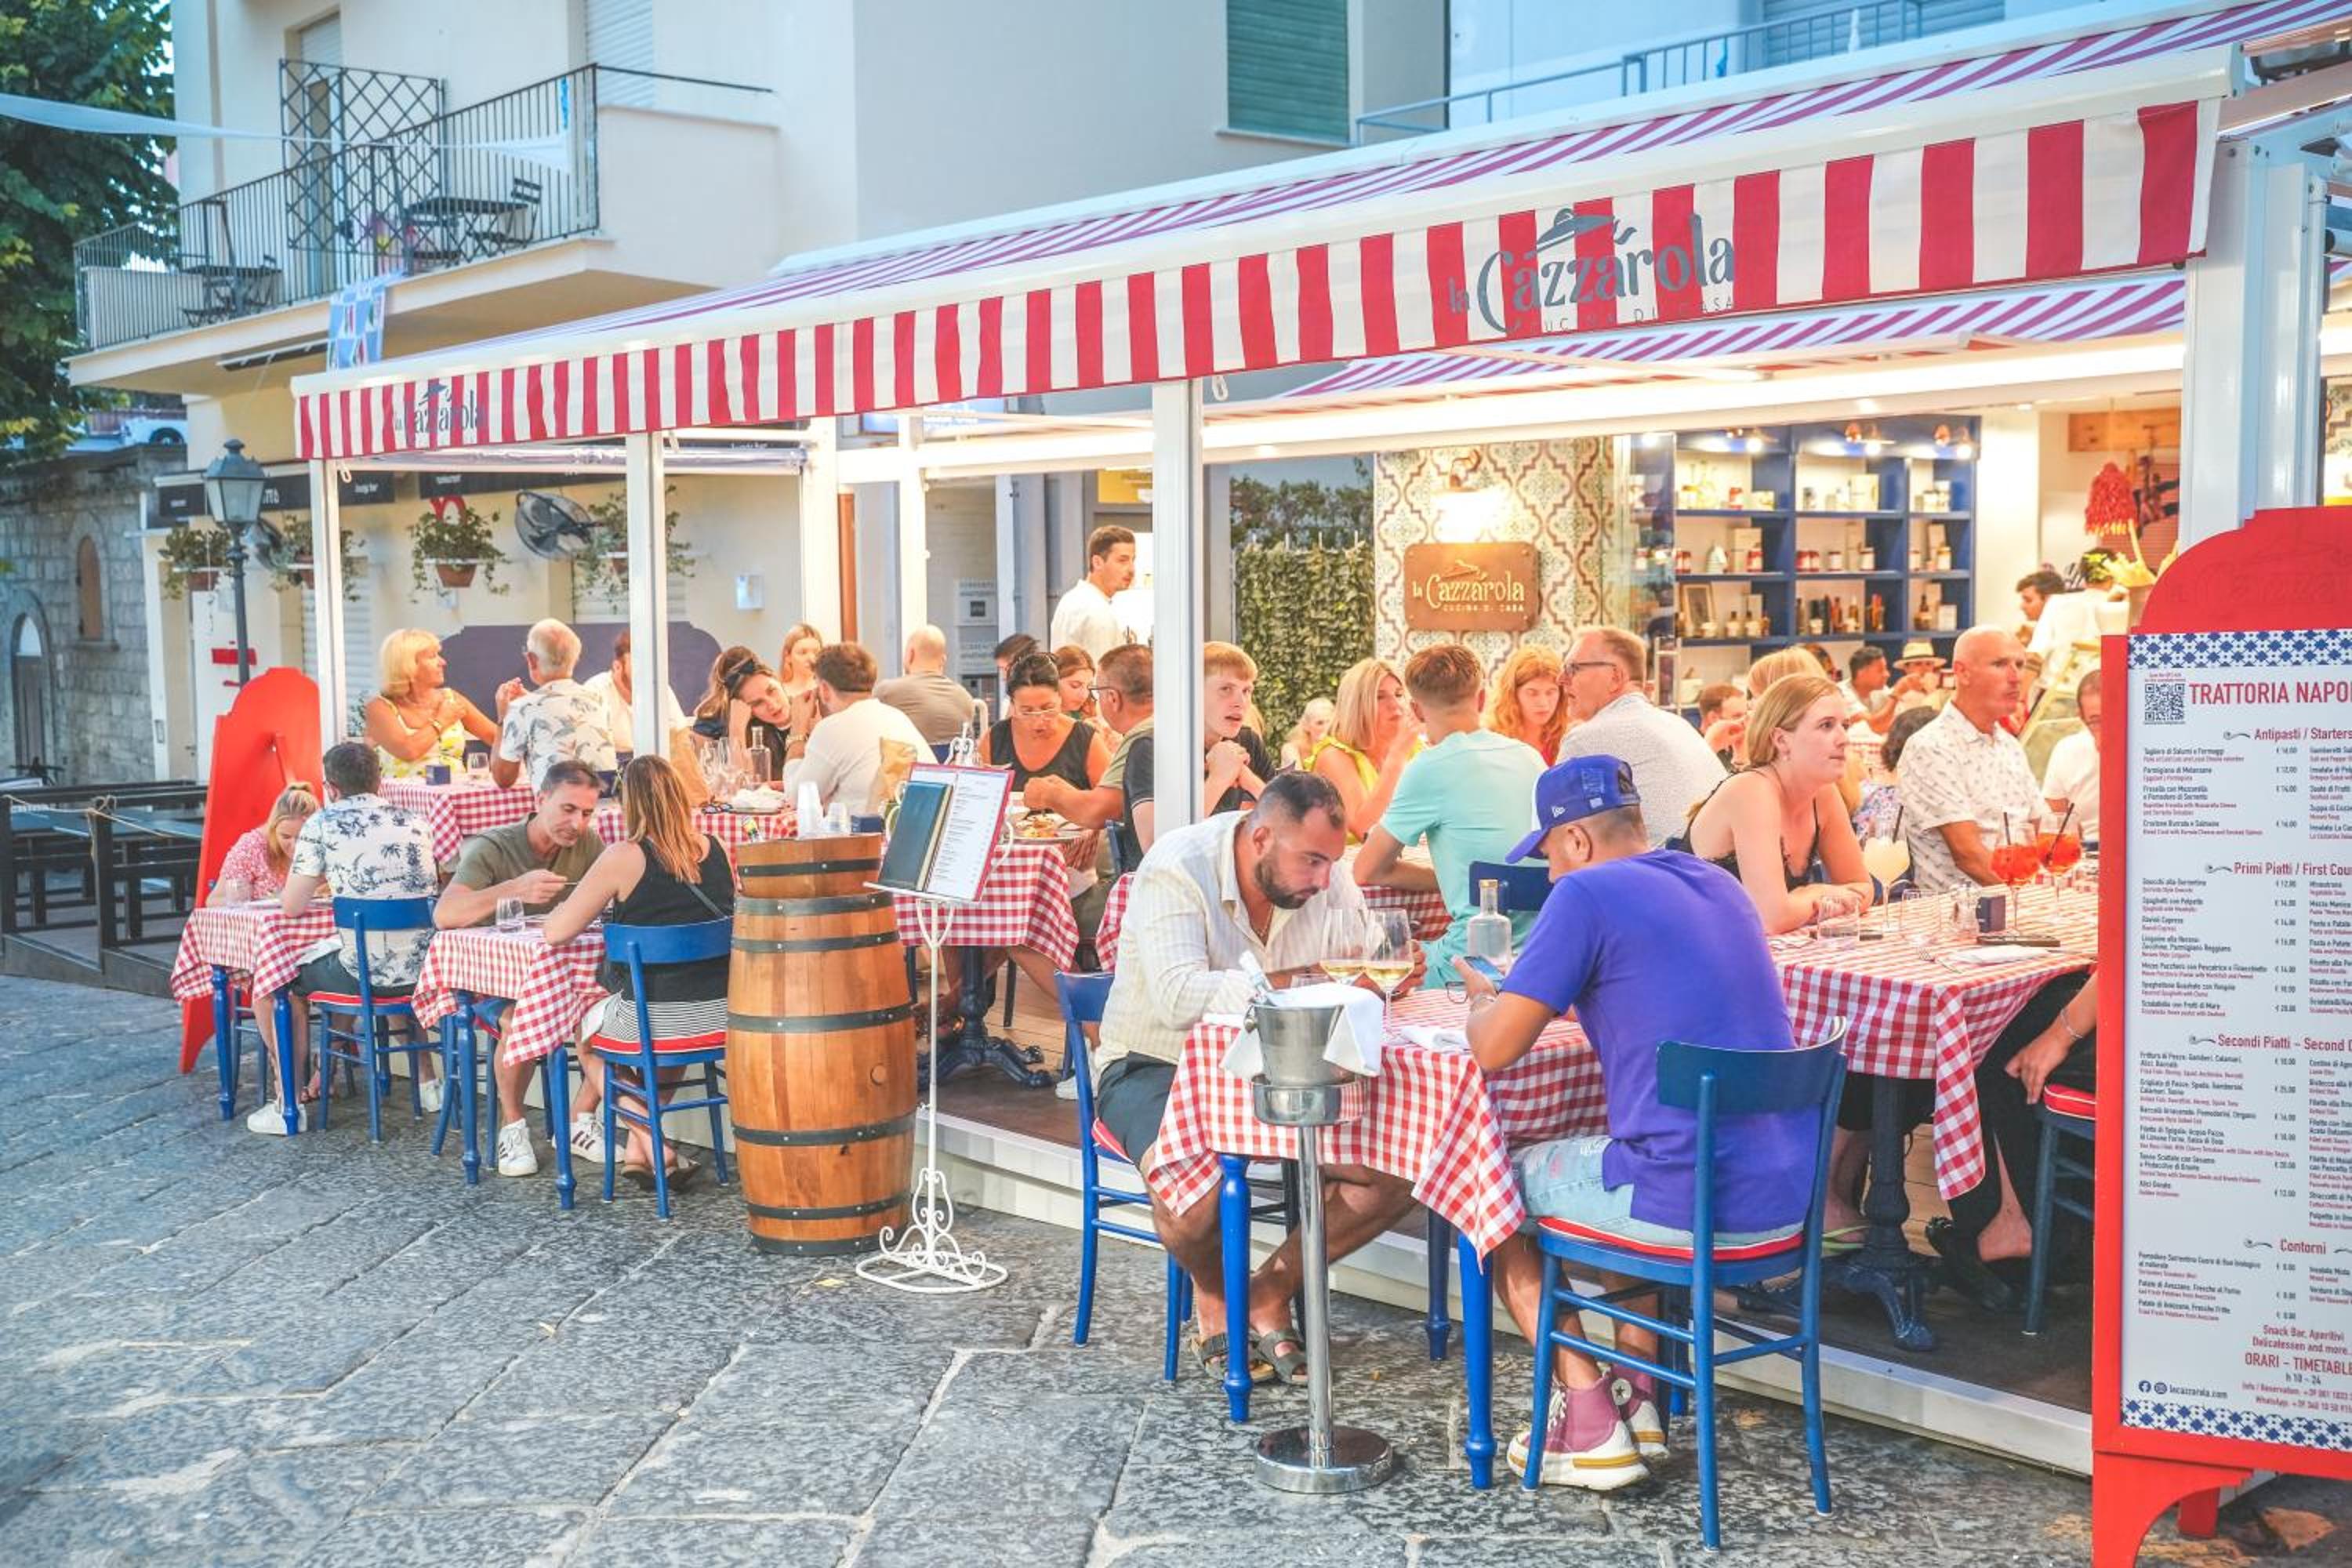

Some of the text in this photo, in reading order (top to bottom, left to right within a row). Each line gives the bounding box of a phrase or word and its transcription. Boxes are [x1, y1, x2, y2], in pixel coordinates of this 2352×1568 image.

[1447, 212, 1734, 333] la Cazzarola
[1412, 569, 1525, 609] la Cazzarola
[2188, 680, 2352, 705] TRATTORIA NAPO
[2254, 728, 2301, 742] Antipasti
[2310, 727, 2352, 739] Starters
[2234, 862, 2262, 874] Primi
[2265, 862, 2292, 876] Piatti
[2303, 862, 2328, 875] First
[2218, 1033, 2260, 1047] Secondi
[2264, 1036, 2291, 1048] Piatti
[2303, 1036, 2345, 1051] Second
[2280, 1239, 2326, 1254] Contorni
[2263, 1325, 2288, 1336] Snack
[2309, 1329, 2345, 1341] Aperitivi
[2252, 1335, 2306, 1350] Delicatessen
[2307, 1343, 2323, 1352] and
[2245, 1352, 2279, 1368] ORARI
